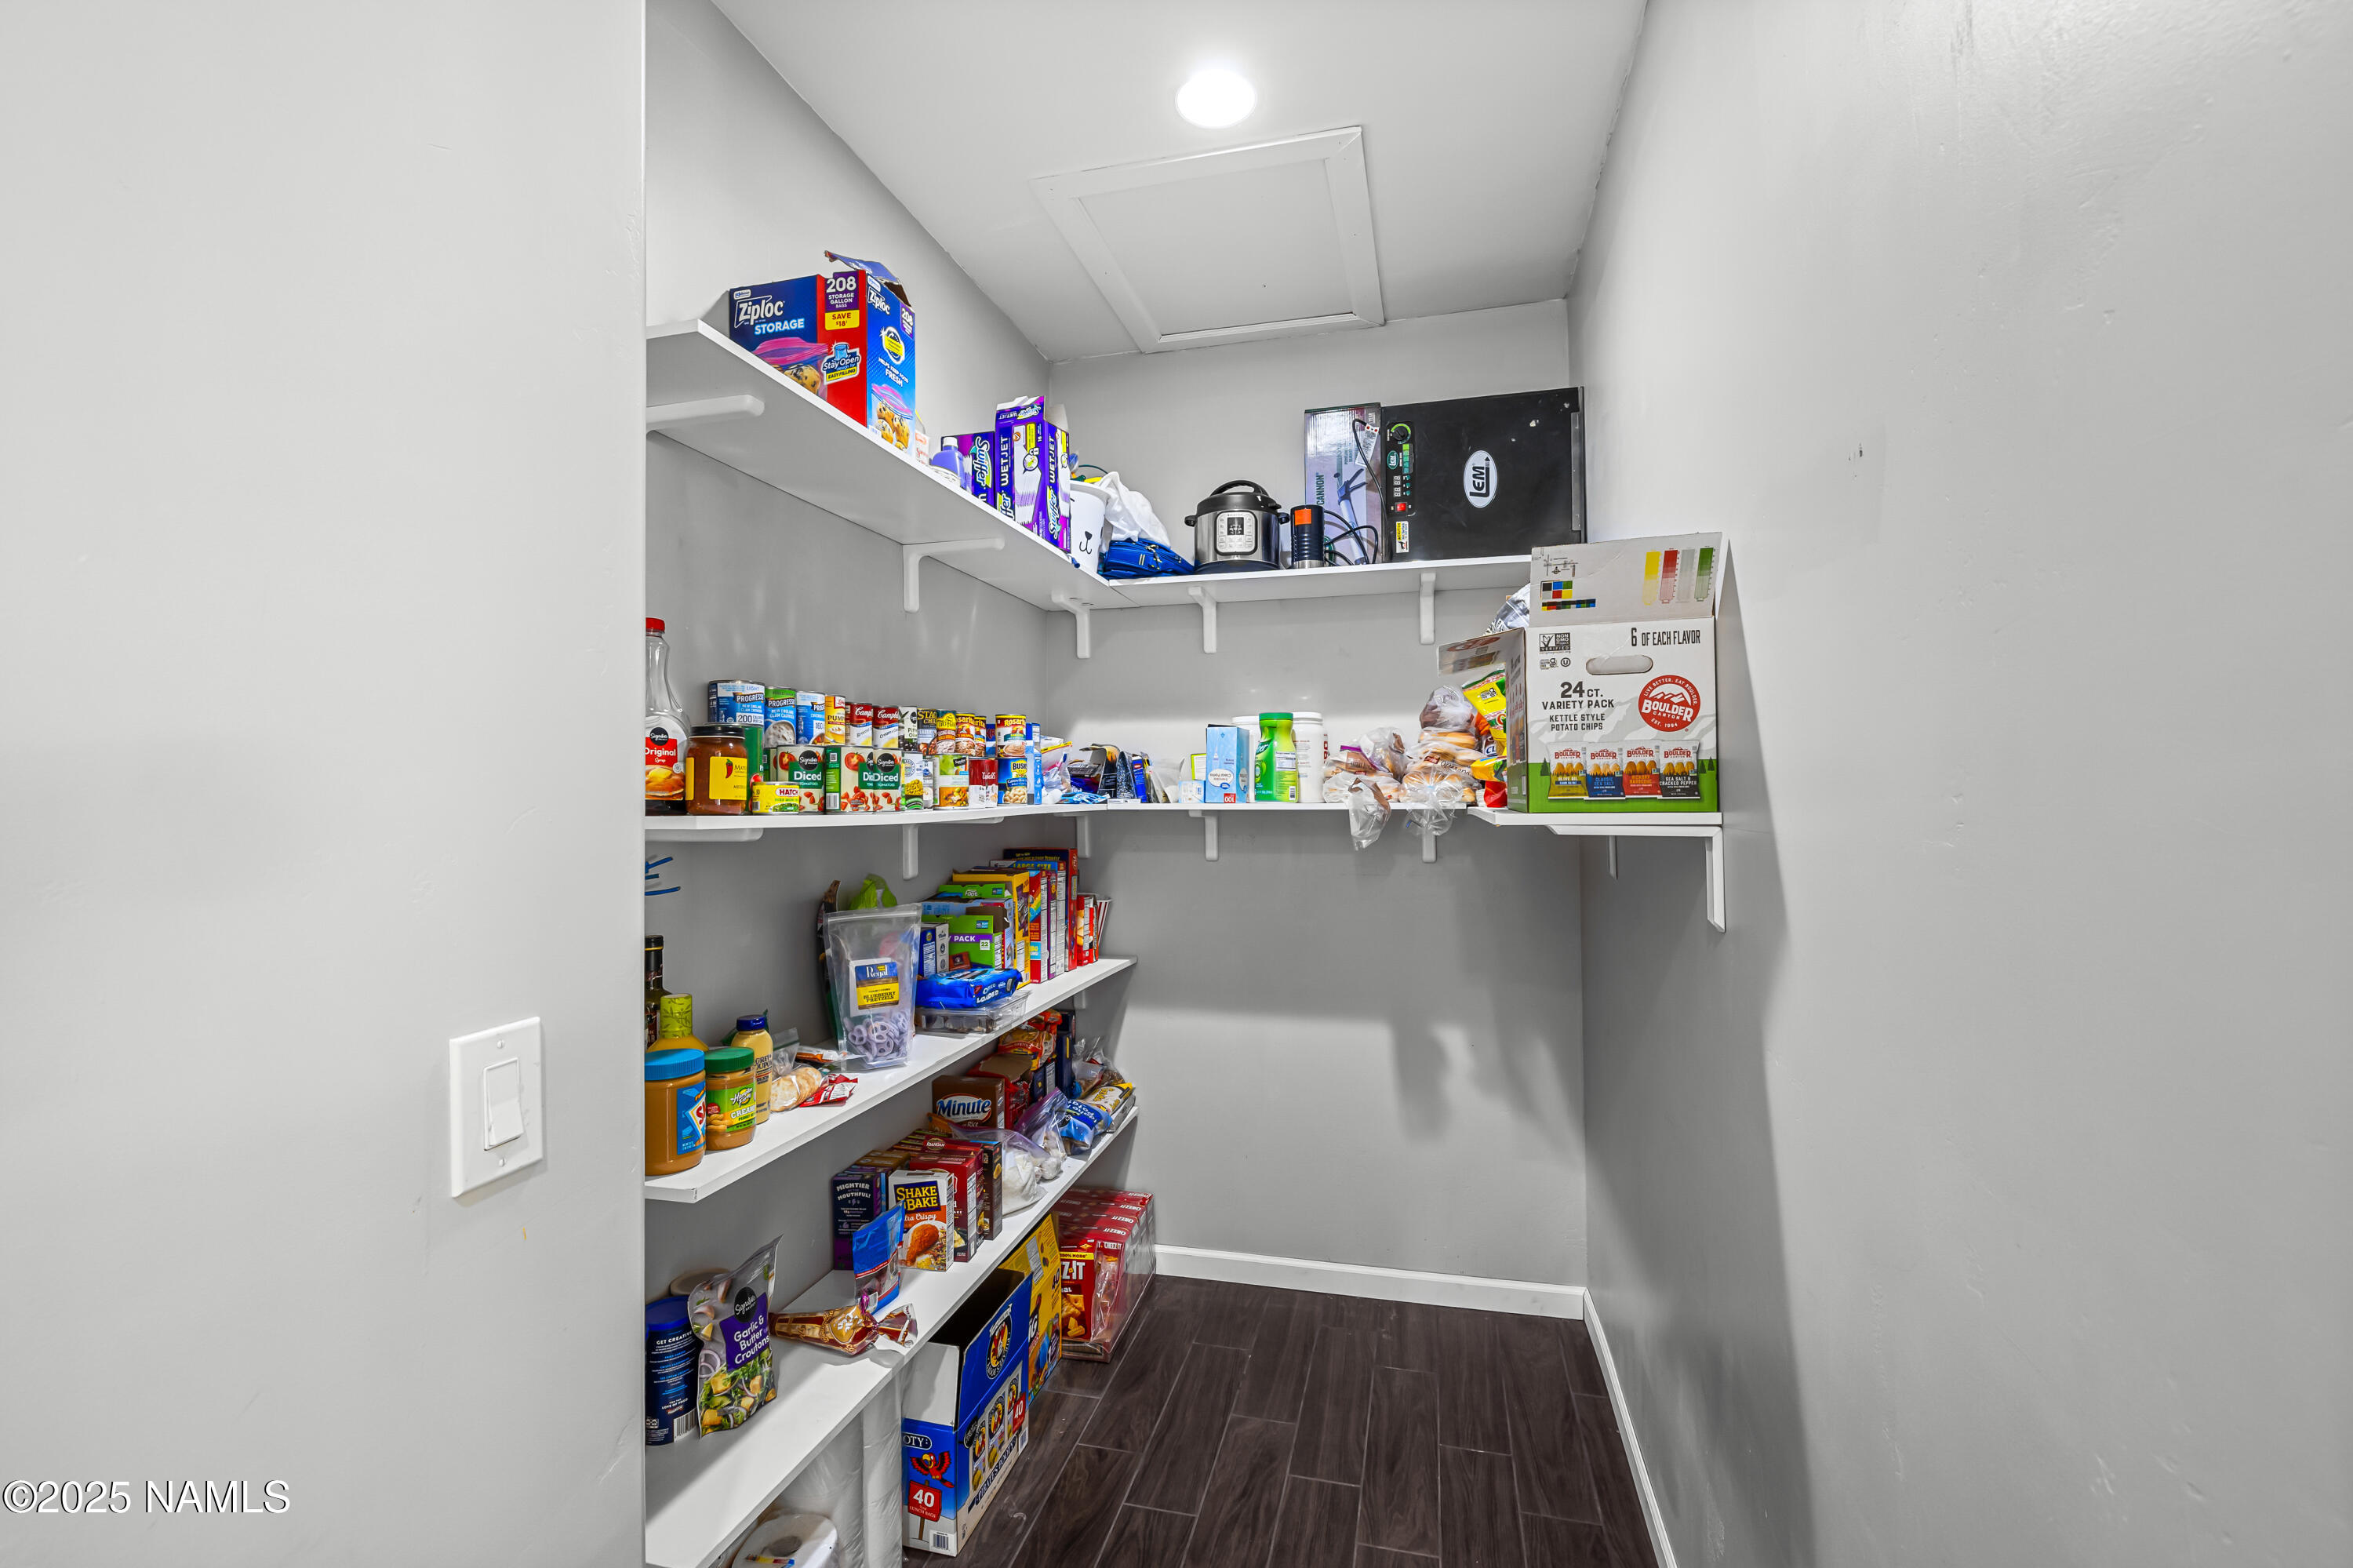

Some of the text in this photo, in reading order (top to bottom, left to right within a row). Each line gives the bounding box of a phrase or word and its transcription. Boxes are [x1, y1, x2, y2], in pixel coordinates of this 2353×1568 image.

[826, 276, 856, 293] 208
[870, 290, 890, 315] Ziploc
[739, 300, 784, 325] Ziploc
[902, 307, 913, 326] 208
[755, 318, 804, 334] STORAGE
[823, 355, 860, 371] Stay Open
[886, 368, 903, 387] FRESH
[973, 435, 990, 486] Swiffer
[1315, 475, 1325, 505] CANNON
[1469, 466, 1490, 498] LEM
[1631, 628, 1700, 646] 6 OF EACH FLAVOR
[1560, 681, 1603, 699] 24 CT.
[1643, 686, 1653, 697] LIVE
[1653, 678, 1673, 687] BETTER.
[1542, 699, 1614, 710] VARIETY PACK
[1642, 698, 1694, 722] BOULDER
[1653, 711, 1680, 720] CANYON
[645, 747, 676, 758] Original
[1664, 750, 1691, 759] BOULDER
[794, 771, 822, 780] Diced
[873, 773, 899, 782] Diced
[976, 989, 999, 1003] LOADED
[937, 1099, 991, 1117] Minute
[836, 1182, 870, 1191] MIGHTIER
[896, 1186, 937, 1202] SHAKE
[838, 1192, 871, 1201] MOUTHFUL!
[907, 1196, 938, 1211] BAKE
[915, 1213, 936, 1221] Crispy
[734, 1315, 764, 1342] Garlic &
[739, 1329, 763, 1351] Butter
[735, 1335, 769, 1364] Croutons
[913, 1489, 935, 1508] 40
[910, 1505, 924, 1515] LUNCH
